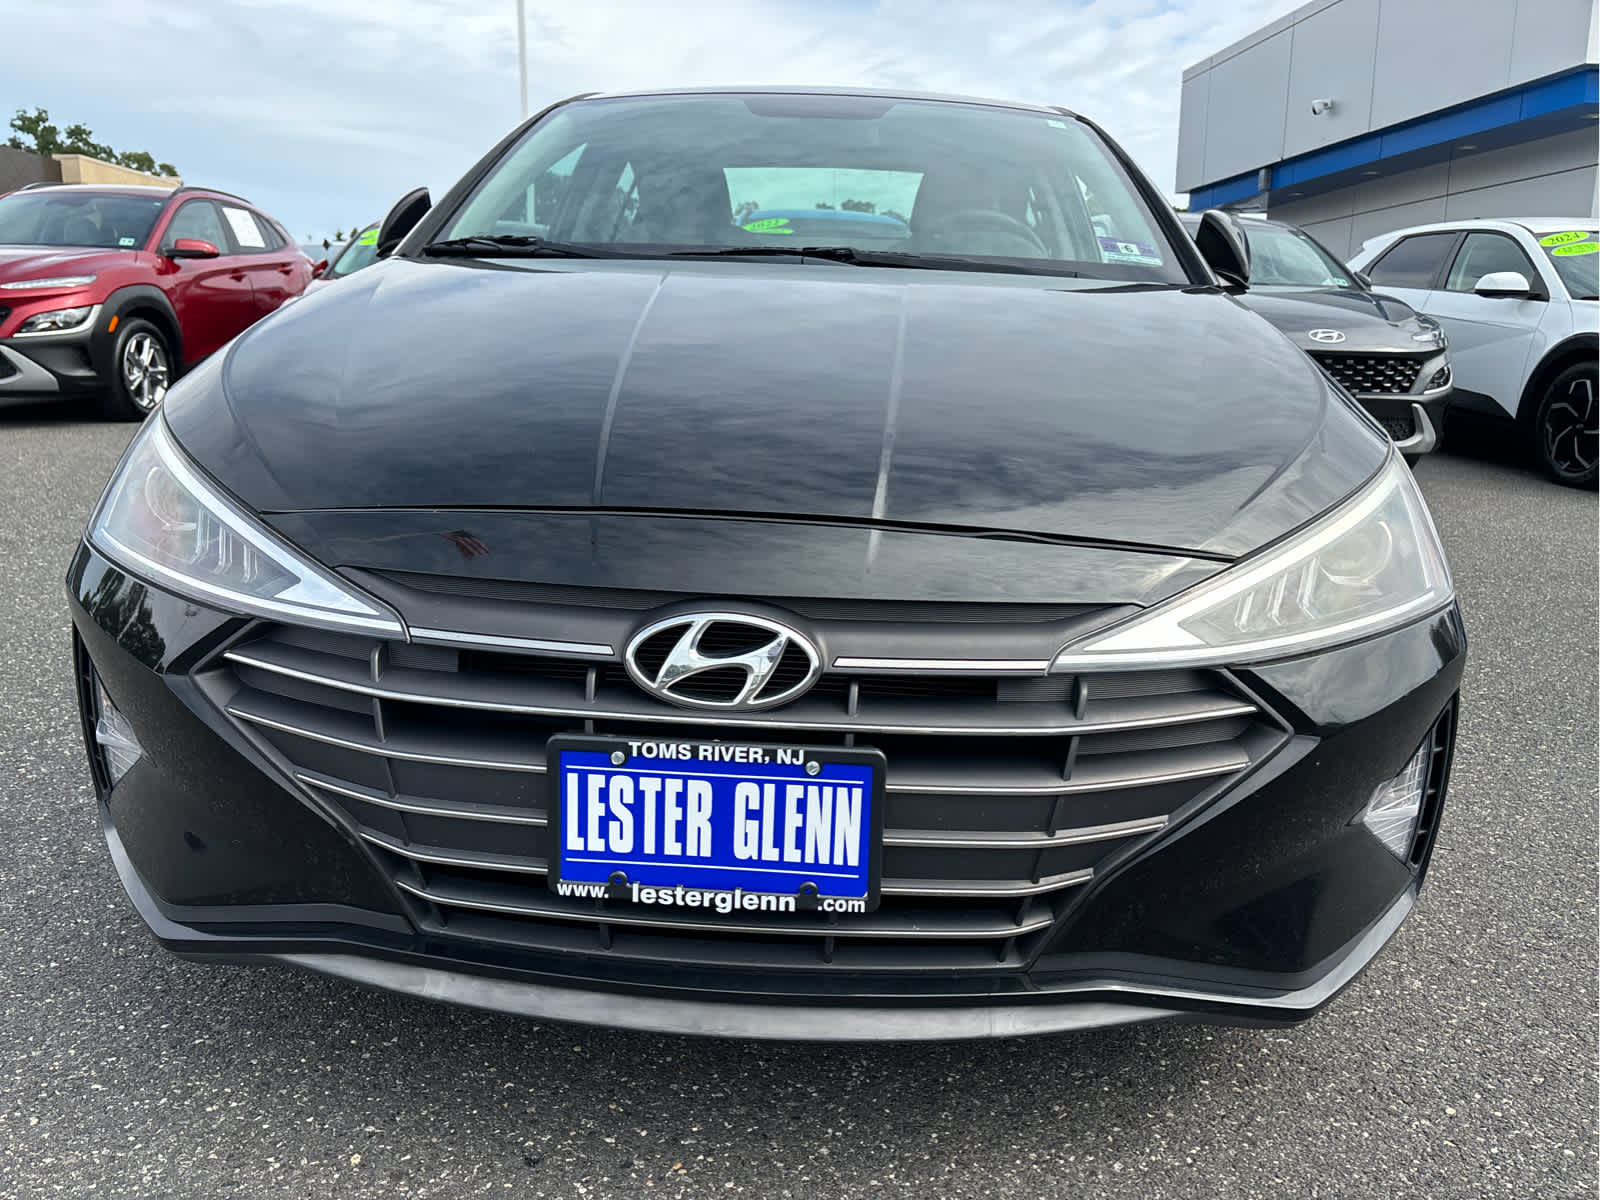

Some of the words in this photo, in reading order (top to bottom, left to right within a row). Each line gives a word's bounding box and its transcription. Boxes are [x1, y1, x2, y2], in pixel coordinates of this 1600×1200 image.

[1551, 232, 1580, 245] 2024
[628, 741, 692, 761] TOMS
[698, 744, 770, 765] RIVER,
[776, 748, 805, 766] NJ
[566, 772, 713, 858] LESTER
[733, 781, 863, 866] GLENN
[556, 882, 609, 899] www.
[631, 882, 796, 914] lesterglenn
[817, 897, 866, 913] .com
